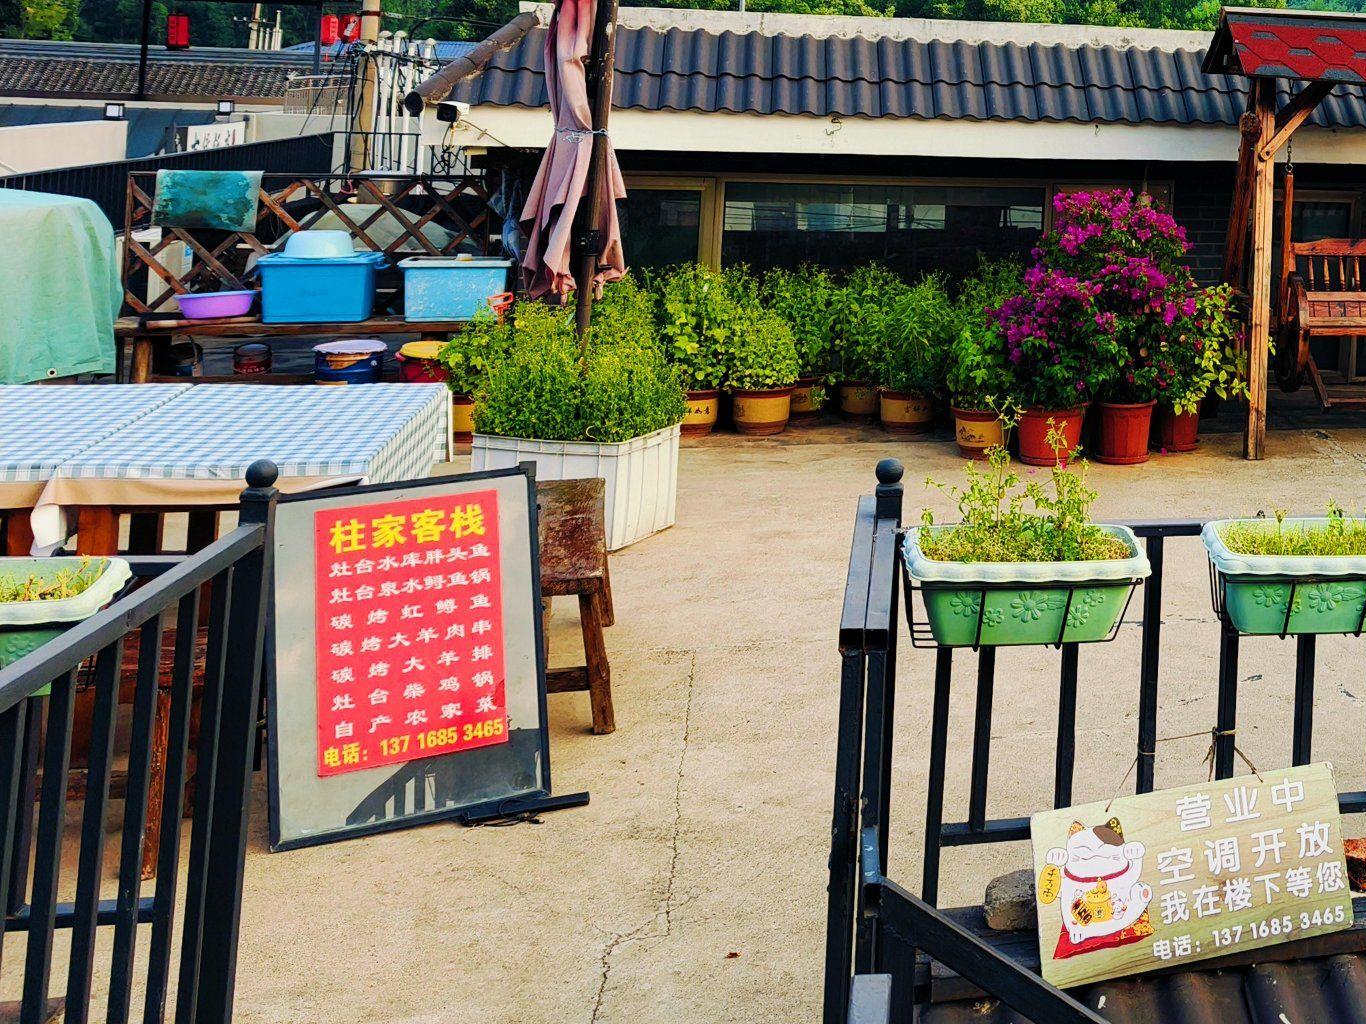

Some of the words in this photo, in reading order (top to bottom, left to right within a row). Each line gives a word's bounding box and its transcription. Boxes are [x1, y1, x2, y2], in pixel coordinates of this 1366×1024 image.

[329, 503, 485, 553] 柱家客栈
[329, 543, 491, 578] 灶台水库胖头鱼
[379, 734, 409, 756] 137
[416, 725, 457, 750] 1685
[462, 718, 503, 742] 3465
[1175, 777, 1305, 832] 营业中
[1156, 820, 1333, 885] 空调开放
[1159, 860, 1345, 925] 我在楼下等您
[1211, 925, 1242, 947] 137
[1249, 915, 1292, 939] 1685
[1300, 905, 1345, 928] 3465
